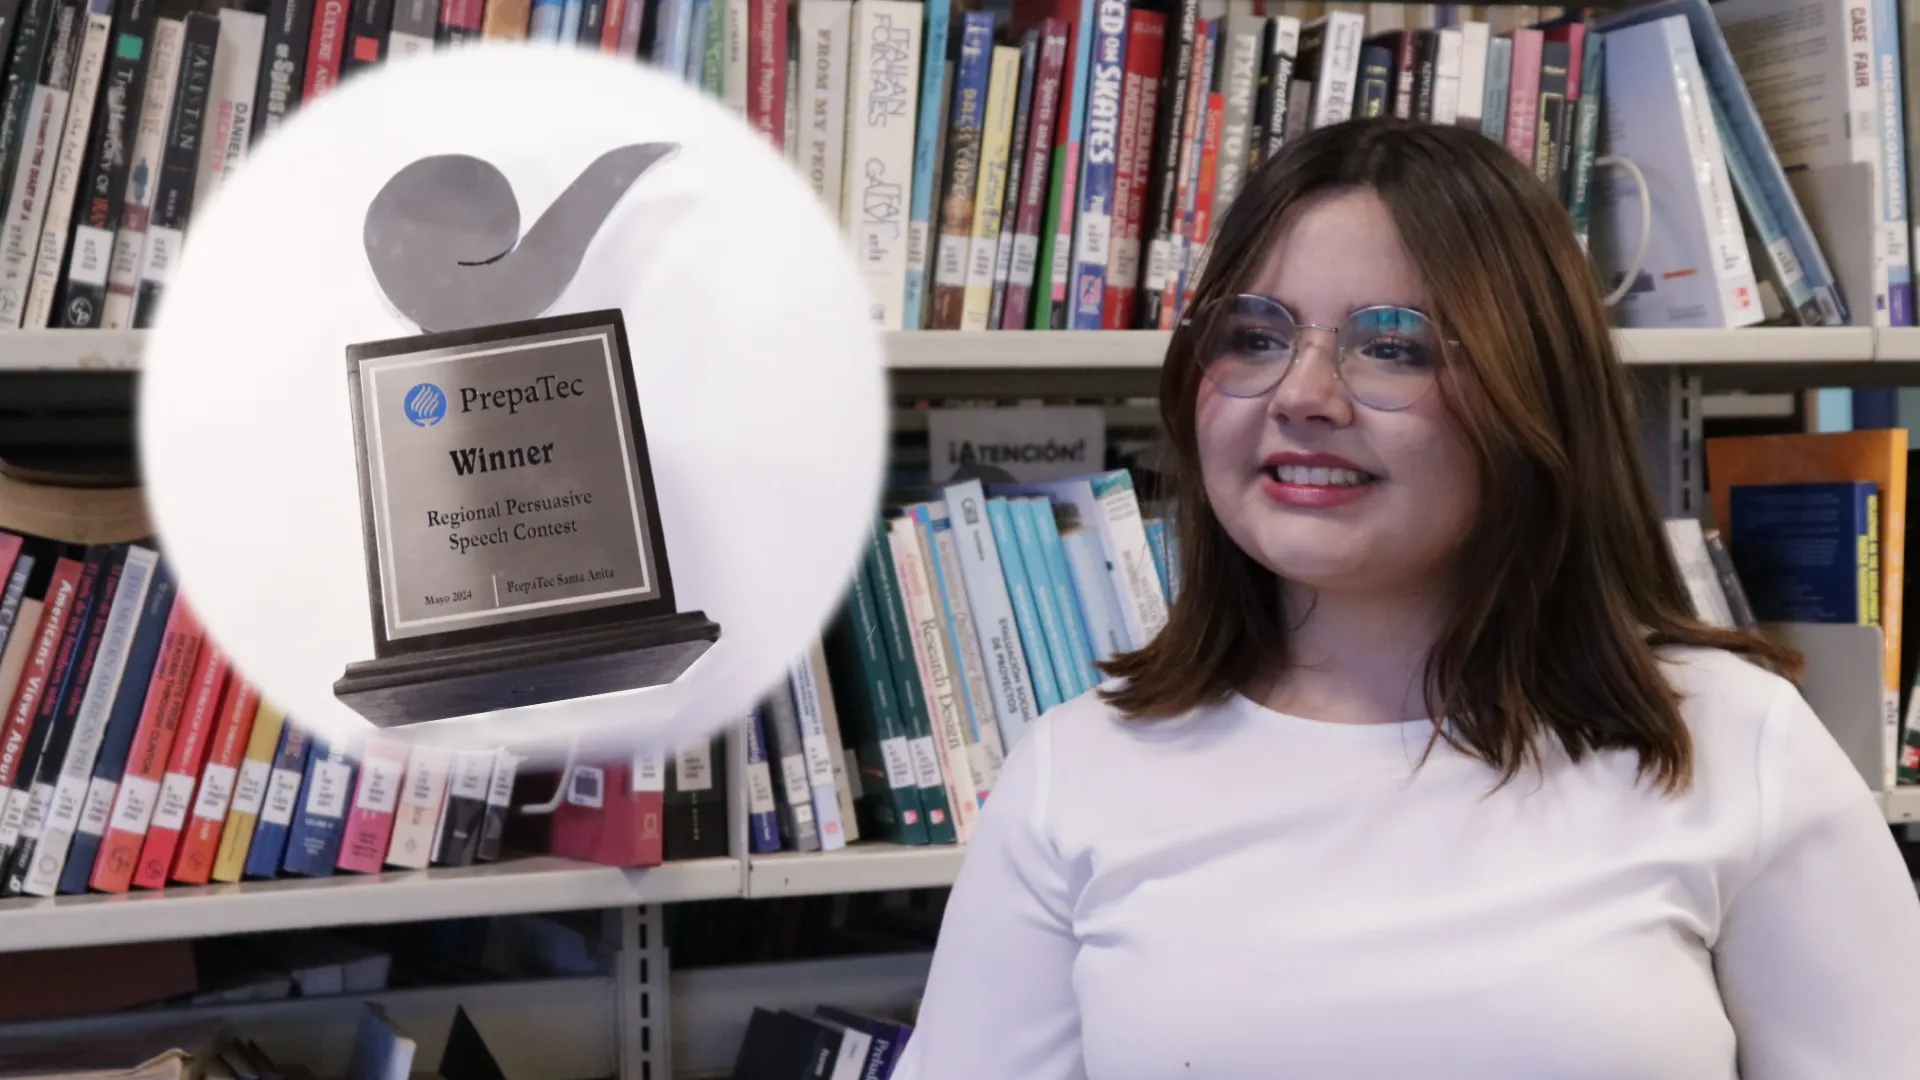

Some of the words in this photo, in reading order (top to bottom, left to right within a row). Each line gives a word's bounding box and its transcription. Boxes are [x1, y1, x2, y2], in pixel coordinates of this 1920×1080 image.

[319, 1, 342, 62] CULTURE
[1850, 7, 1868, 43] CASE
[815, 28, 832, 91] FROM
[867, 12, 892, 128] FOLKTALES
[887, 27, 911, 117] ITALIAN
[1853, 52, 1869, 89] FAIR
[179, 43, 211, 150] PAKISTAN
[814, 99, 830, 133] MY
[1036, 77, 1059, 121] Sports
[1088, 63, 1123, 165] SKATES
[1117, 72, 1139, 172] AMERICAN
[1272, 57, 1291, 133] Marathon
[228, 102, 249, 160] DANIEL
[1036, 123, 1051, 148] and
[1132, 77, 1158, 188] BASEBALL
[1204, 108, 1218, 151] Smart
[95, 174, 109, 194] OF
[1027, 152, 1046, 206] Athletes
[1575, 150, 1592, 204] Masters
[459, 374, 586, 415] PrepaTec
[449, 442, 554, 476] Winner
[948, 436, 1087, 466] ¡ATENCIÓN!
[426, 502, 502, 531] Regional
[506, 490, 594, 516] Persuasive
[448, 522, 510, 555] Speech
[512, 518, 578, 542] Contest
[424, 592, 450, 607] Mayo
[452, 589, 473, 603] 2024
[506, 575, 555, 596] PrepaTec
[556, 572, 586, 588] Santa
[587, 567, 616, 582] Anita
[101, 603, 133, 670] MODERN
[991, 637, 1002, 651] DE
[918, 617, 947, 689] Research
[934, 692, 961, 750] Design
[995, 653, 1018, 715] PROYECTOS
[997, 617, 1022, 684] EVALUACIÓN
[1011, 686, 1035, 726] SOCIAL
[14, 674, 45, 726] Views
[79, 673, 109, 745] AMERICAN
[0, 729, 23, 785] About
[139, 729, 162, 775] CLINTON
